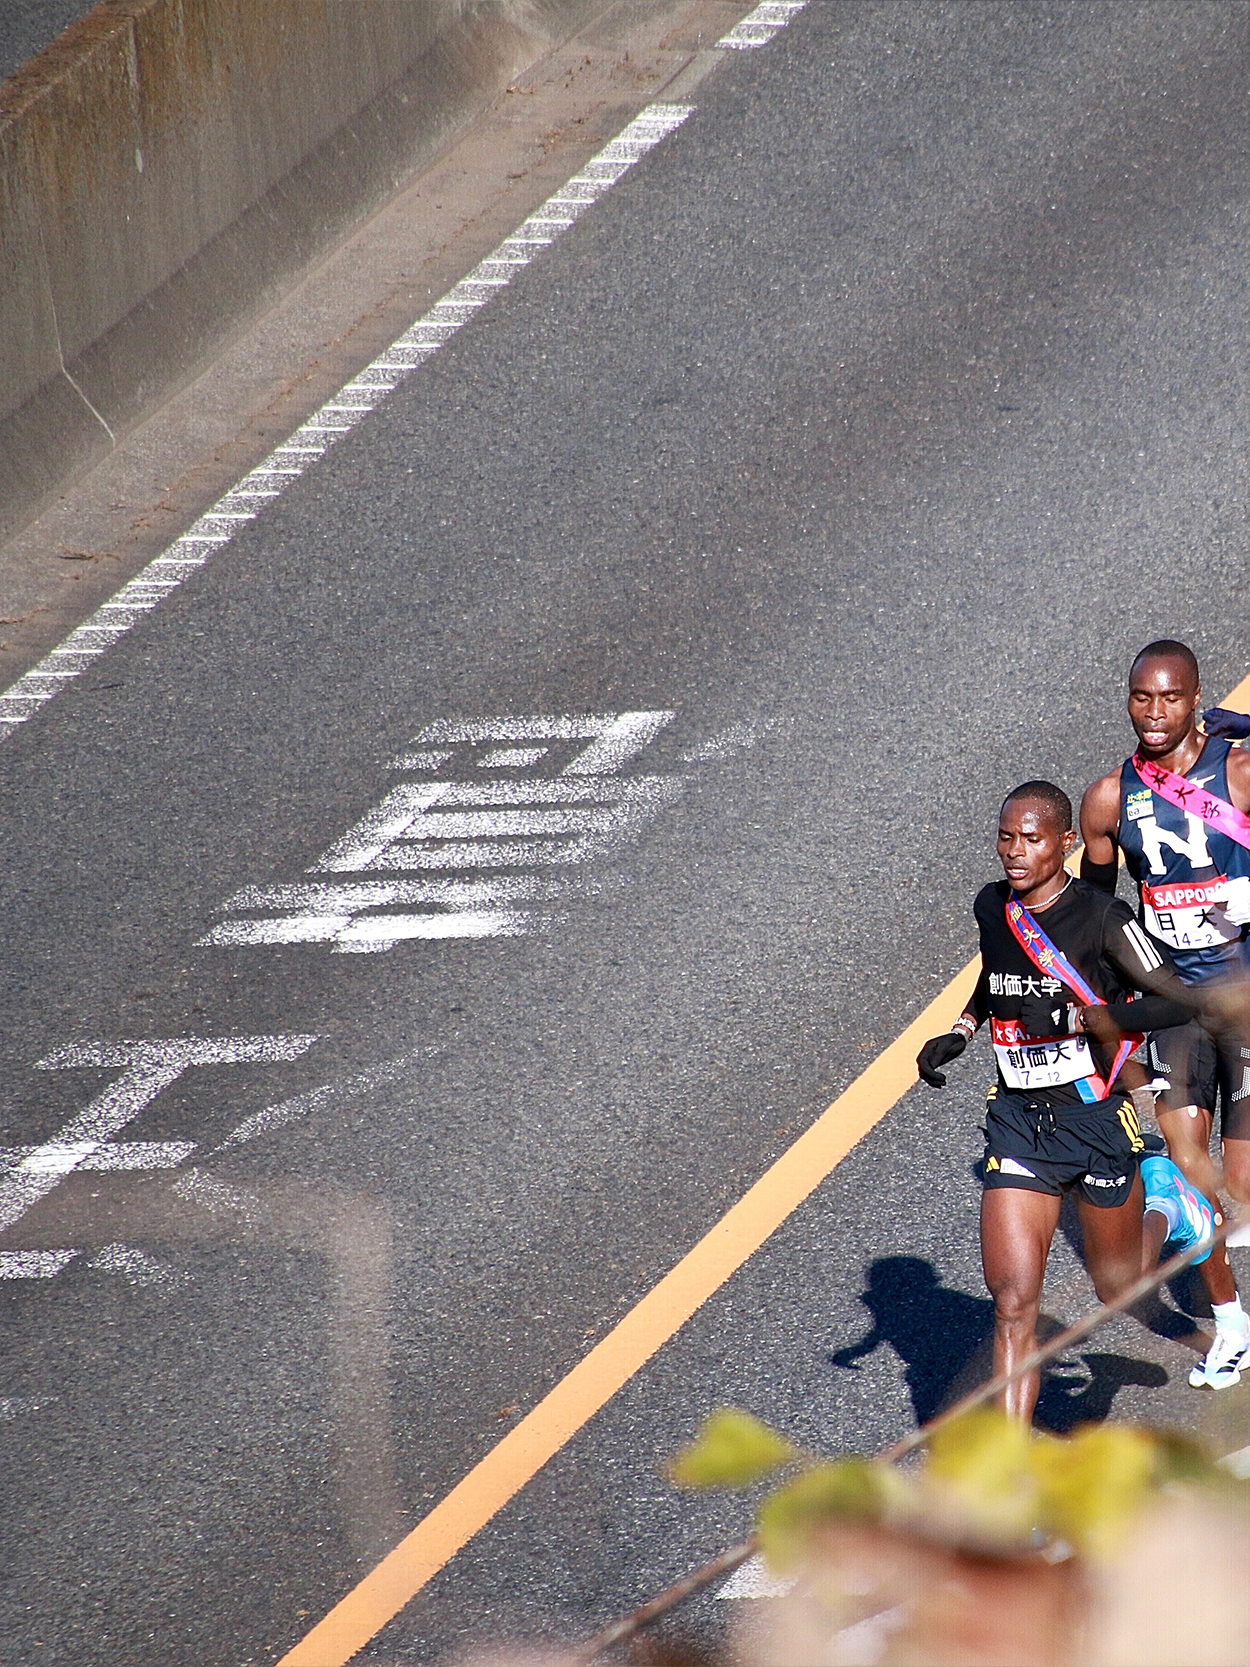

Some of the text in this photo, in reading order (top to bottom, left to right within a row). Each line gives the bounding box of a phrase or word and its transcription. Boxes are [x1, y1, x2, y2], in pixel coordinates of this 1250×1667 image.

[1157, 908, 1218, 931] 日大
[1172, 932, 1214, 947] 14-2
[989, 972, 1063, 998] 創価大学
[1006, 1043, 1072, 1069] 創価大
[1020, 1070, 1061, 1086] 7-12
